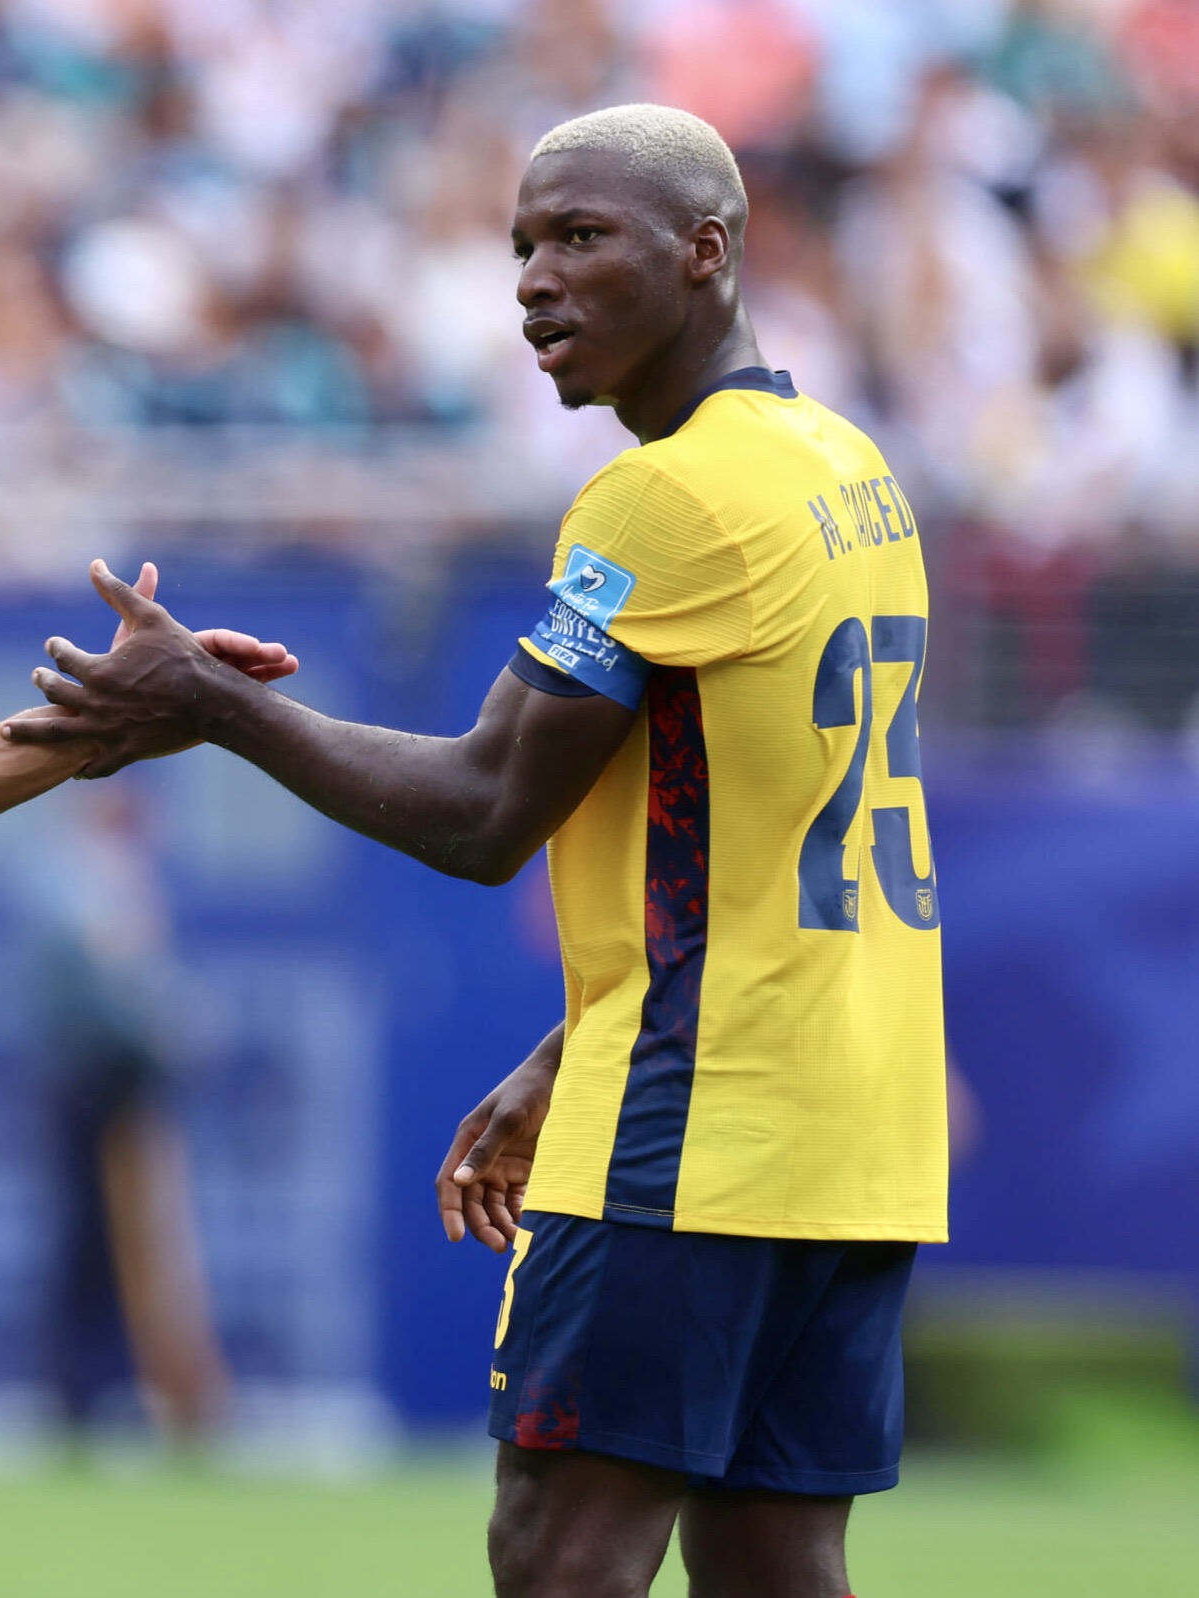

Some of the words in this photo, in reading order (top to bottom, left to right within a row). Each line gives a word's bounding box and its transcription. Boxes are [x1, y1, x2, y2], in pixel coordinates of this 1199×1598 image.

[807, 494, 852, 560] M.
[839, 475, 914, 548] CAICED
[549, 645, 576, 665] FIFA
[798, 615, 940, 933] 23
